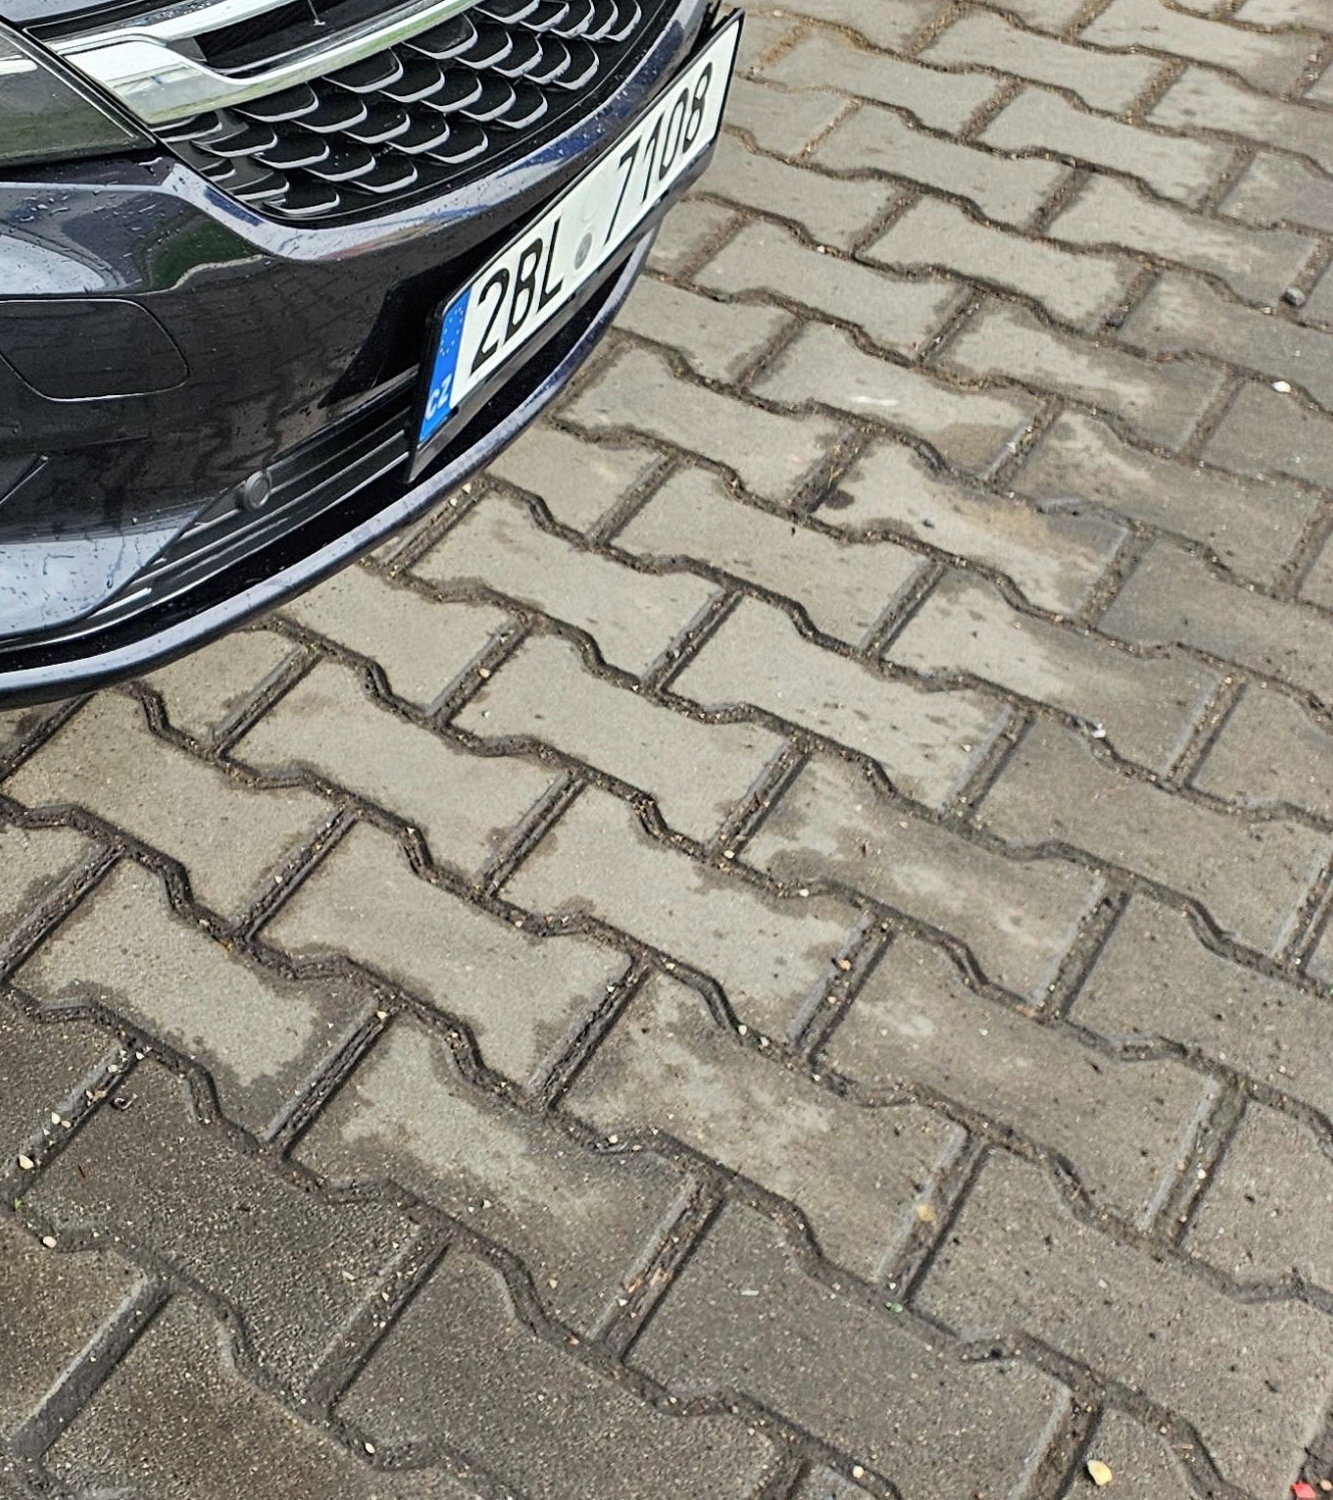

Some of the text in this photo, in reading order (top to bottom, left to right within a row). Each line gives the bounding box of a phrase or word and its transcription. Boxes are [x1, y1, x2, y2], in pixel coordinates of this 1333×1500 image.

[469, 61, 713, 377] 2BL 7108
[425, 372, 453, 421] CZ
